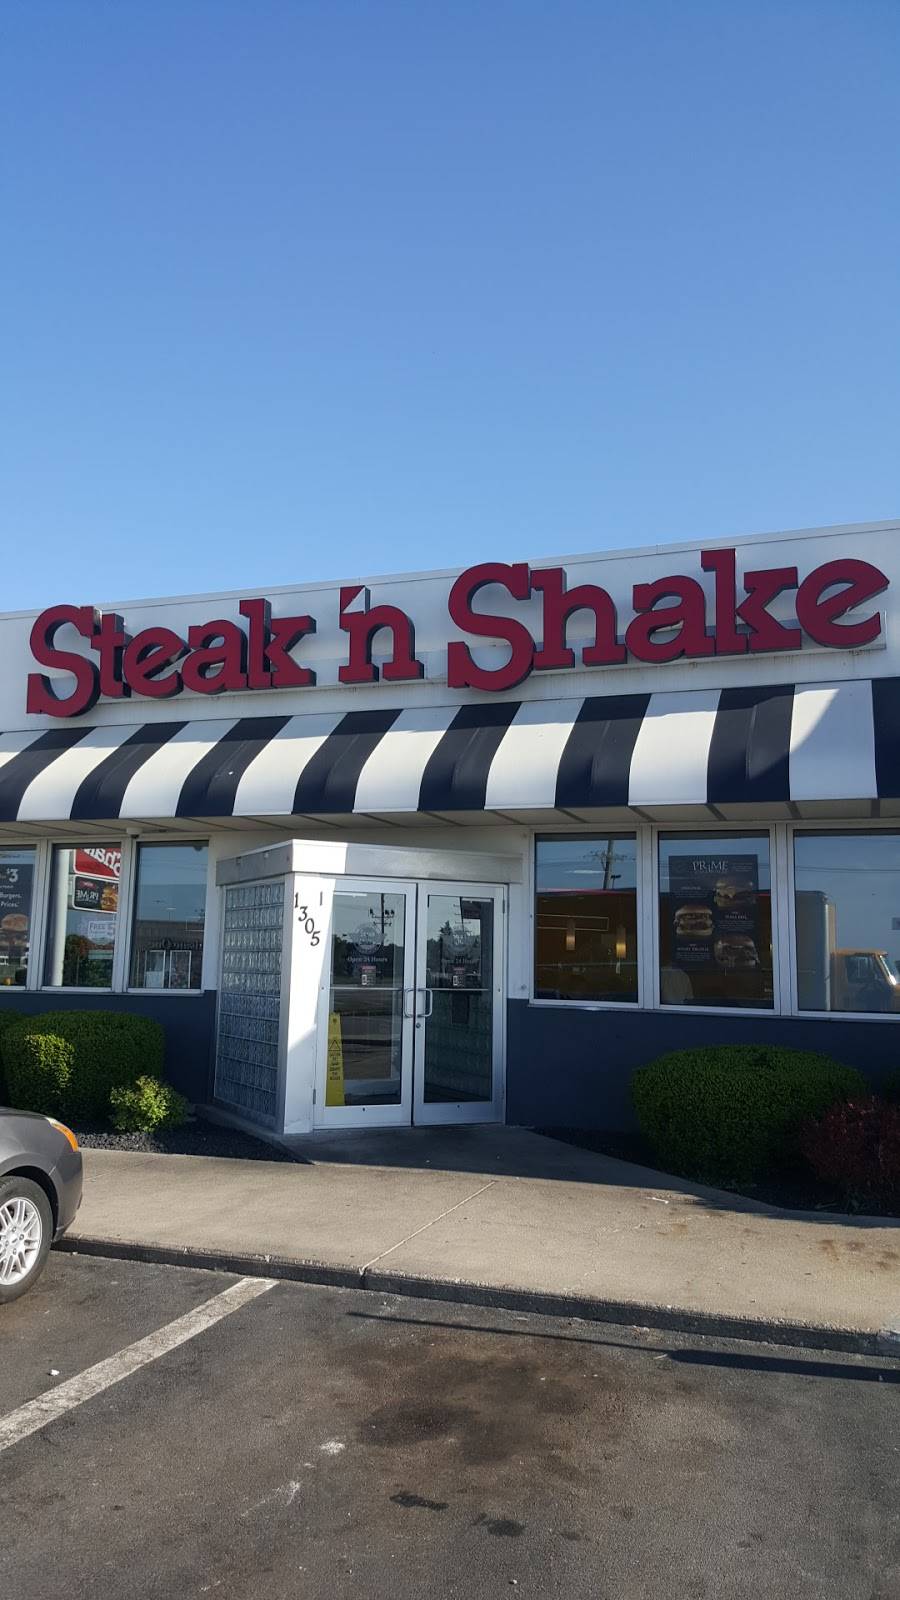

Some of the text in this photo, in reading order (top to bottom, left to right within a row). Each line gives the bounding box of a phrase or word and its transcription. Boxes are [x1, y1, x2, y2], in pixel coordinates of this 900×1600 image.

[26, 599, 316, 718] Steak
[447, 548, 890, 692] Shake
[295, 891, 320, 946] 1305
